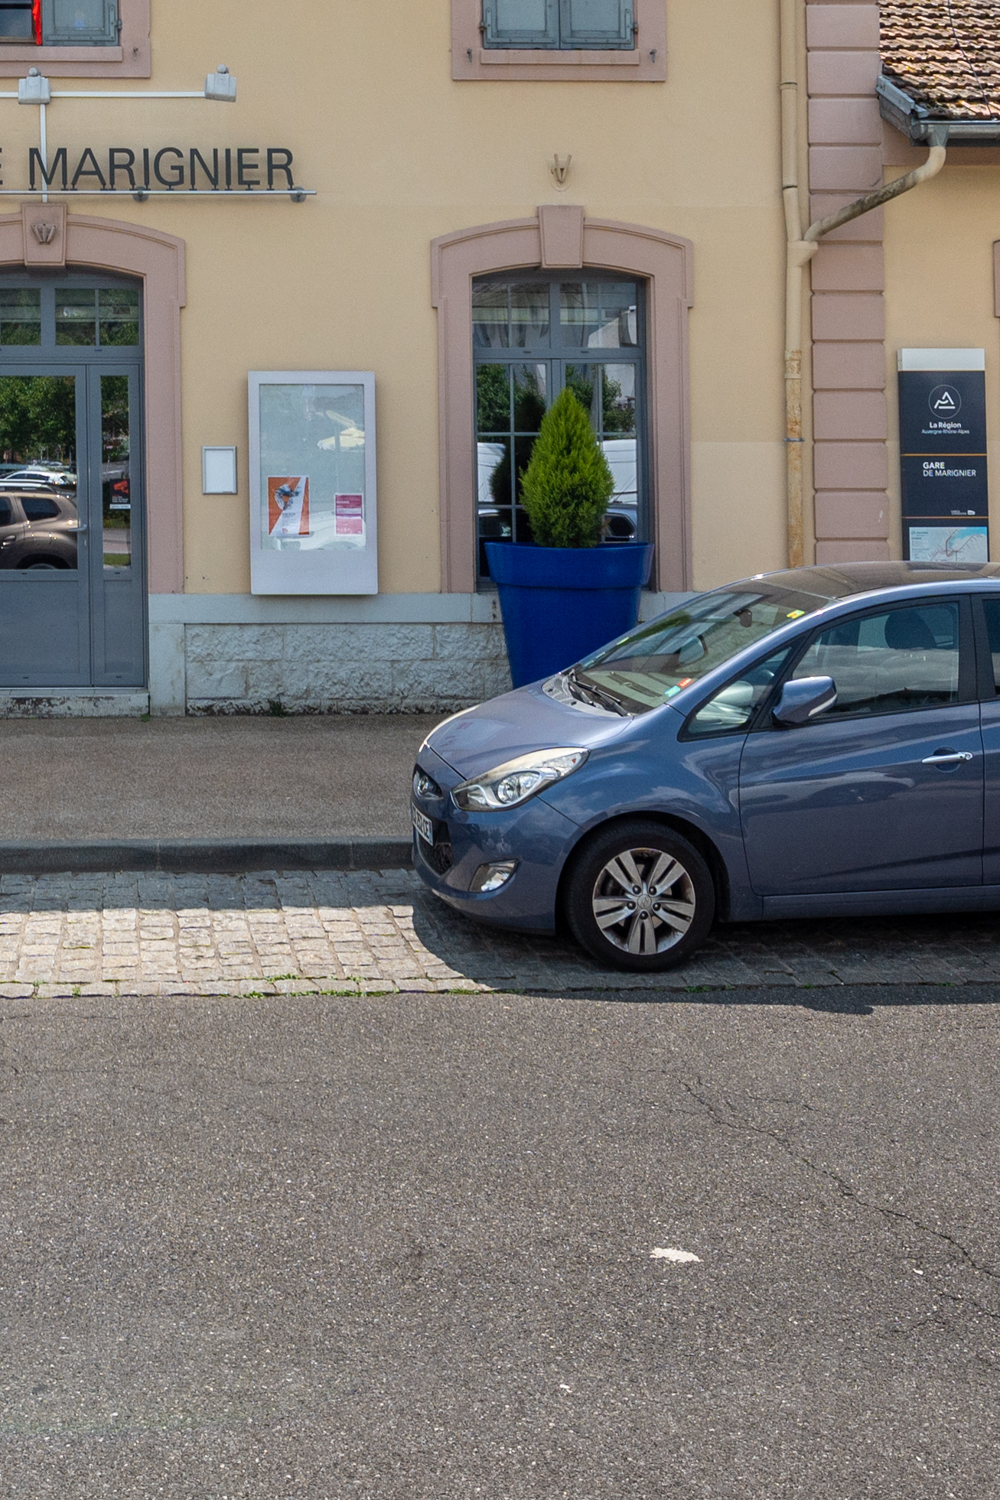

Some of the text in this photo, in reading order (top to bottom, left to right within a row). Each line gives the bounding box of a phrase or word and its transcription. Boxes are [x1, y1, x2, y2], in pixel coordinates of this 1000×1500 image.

[28, 146, 296, 189] MARIGNIER
[929, 421, 962, 430] La Région
[922, 461, 945, 470] GARE
[923, 469, 977, 477] DE MARIGNIER
